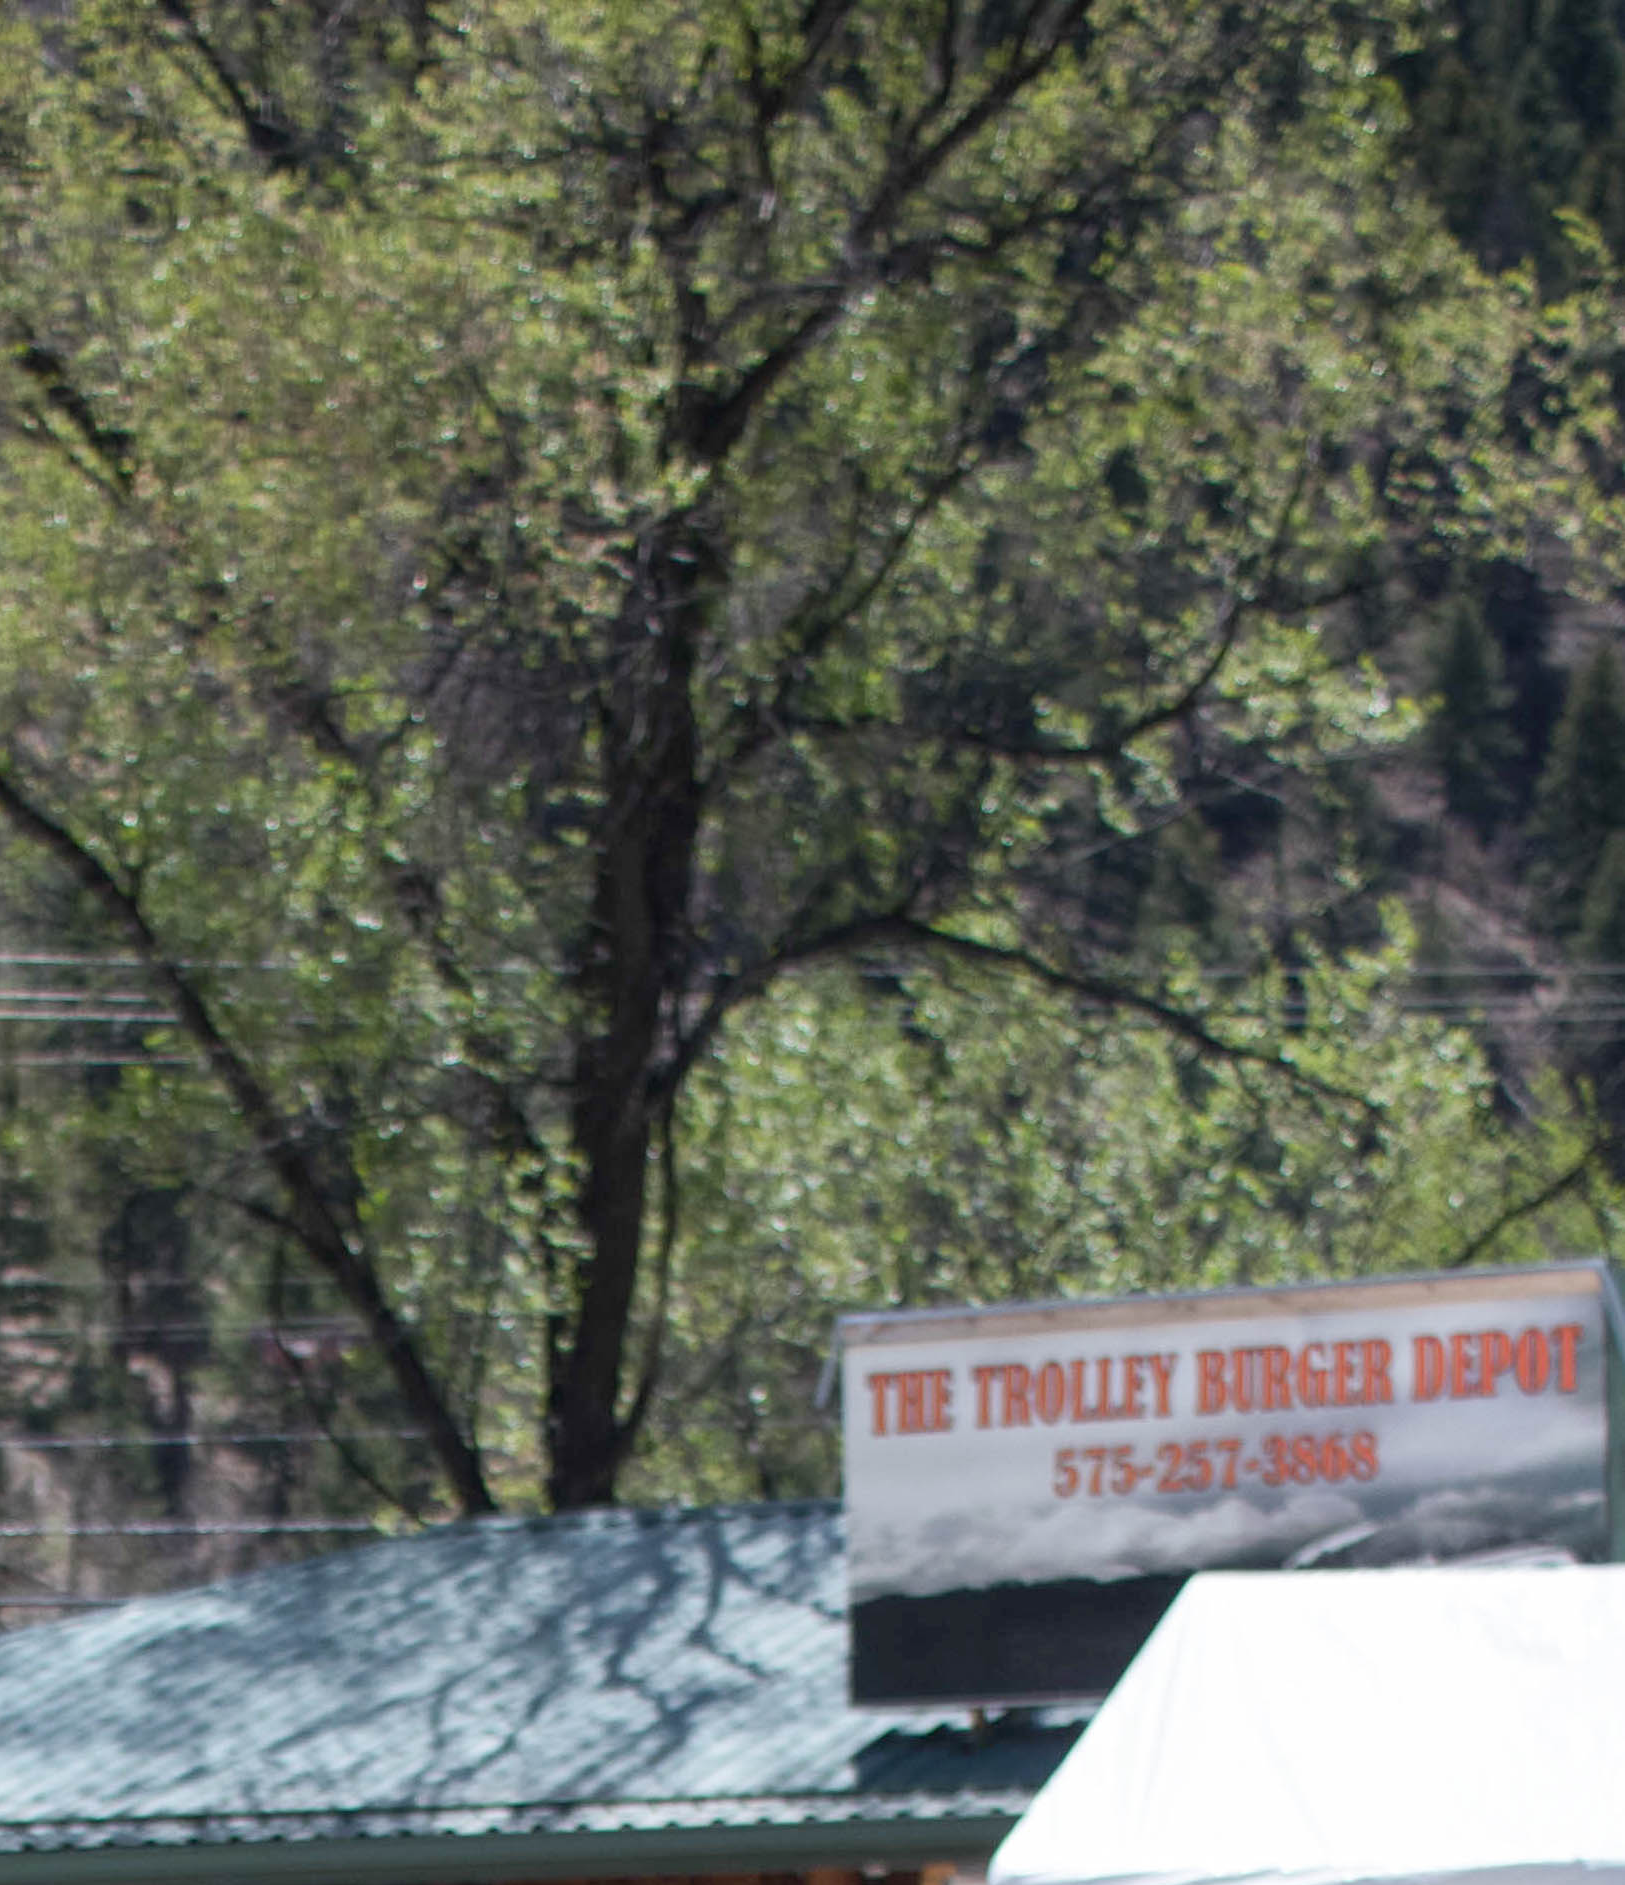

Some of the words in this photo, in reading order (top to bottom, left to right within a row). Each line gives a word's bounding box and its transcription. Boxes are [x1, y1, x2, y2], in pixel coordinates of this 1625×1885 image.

[868, 1367, 953, 1437] THE
[971, 1352, 1177, 1429] TROLLEY
[1194, 1337, 1394, 1417] BURGER
[1410, 1323, 1584, 1403] DEPOT
[1053, 1432, 1380, 1499] 575-257-3868
